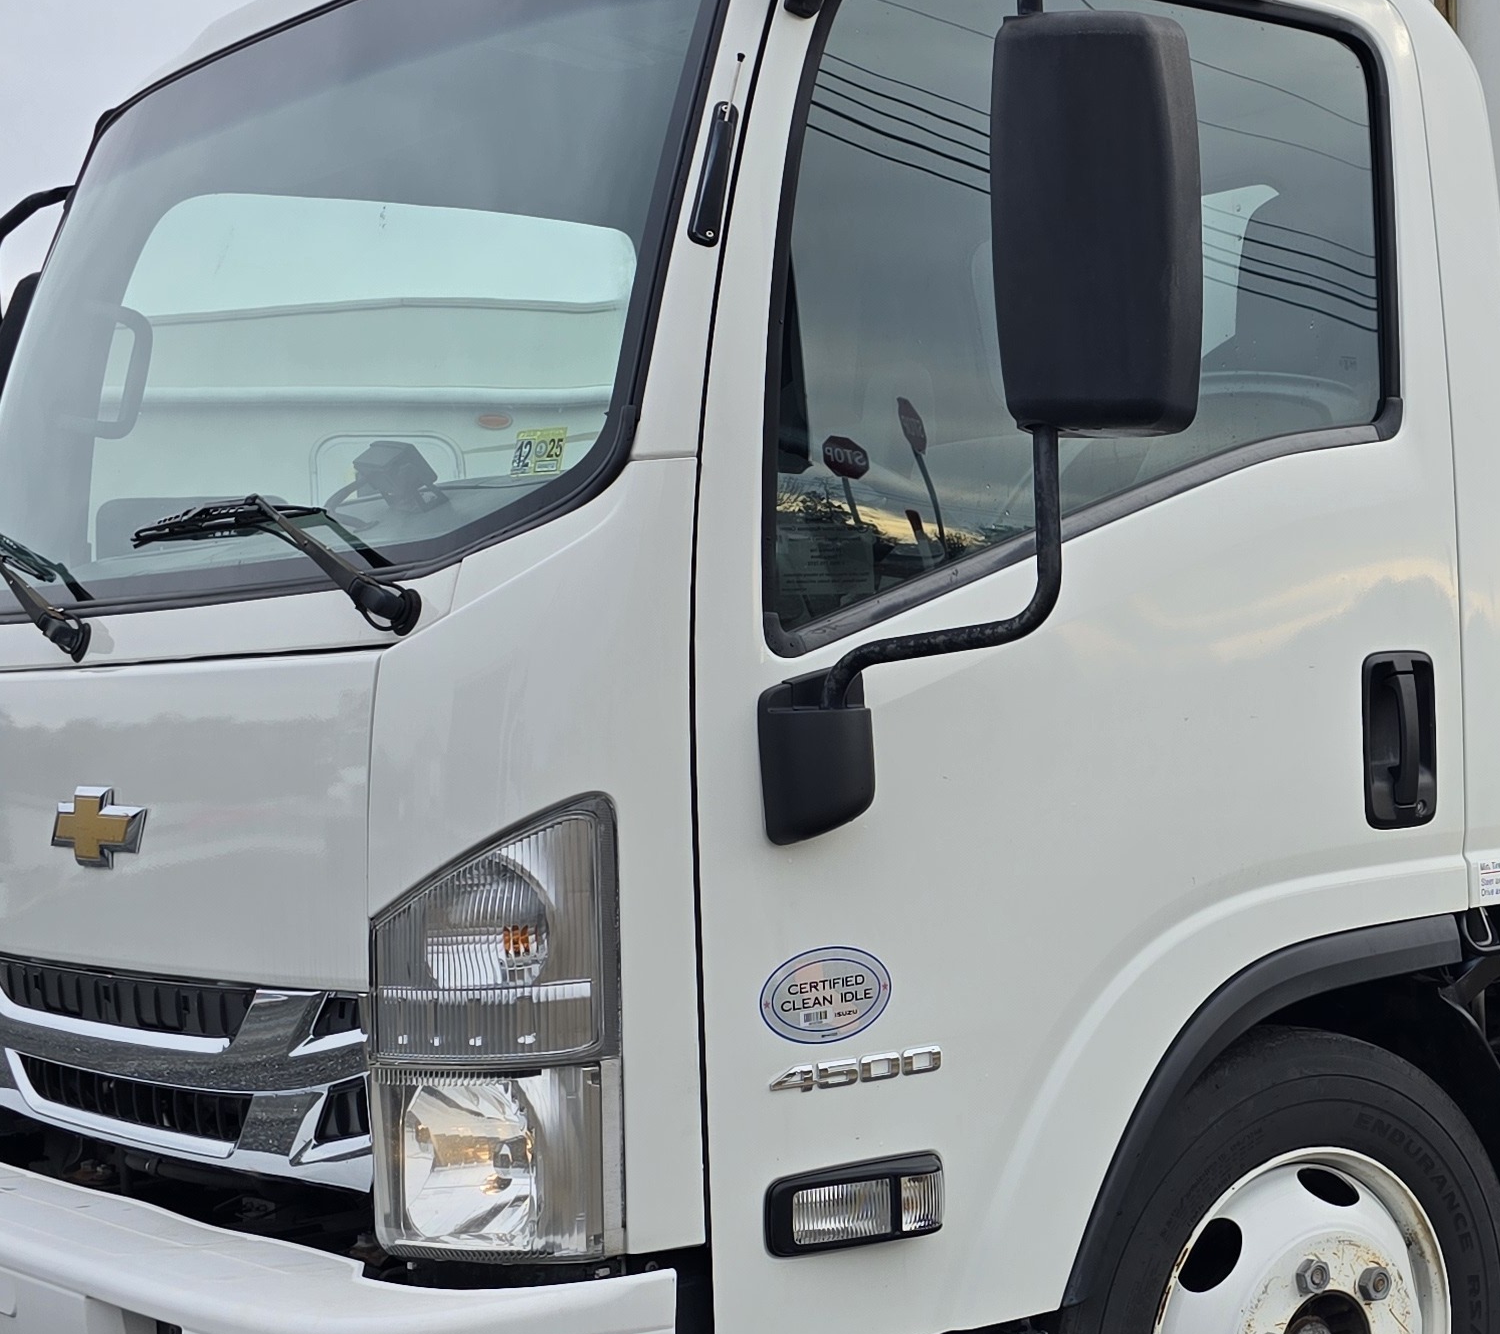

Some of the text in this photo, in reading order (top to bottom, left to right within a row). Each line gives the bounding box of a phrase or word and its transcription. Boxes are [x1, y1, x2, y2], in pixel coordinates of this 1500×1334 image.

[546, 438, 564, 458] 25
[787, 974, 865, 996] CERTIFIED
[780, 988, 874, 1013] CLEAN IDLE
[834, 1008, 858, 1018] ISUZU
[769, 1045, 942, 1093] 4500
[1352, 1111, 1474, 1252] ENDURANCE
